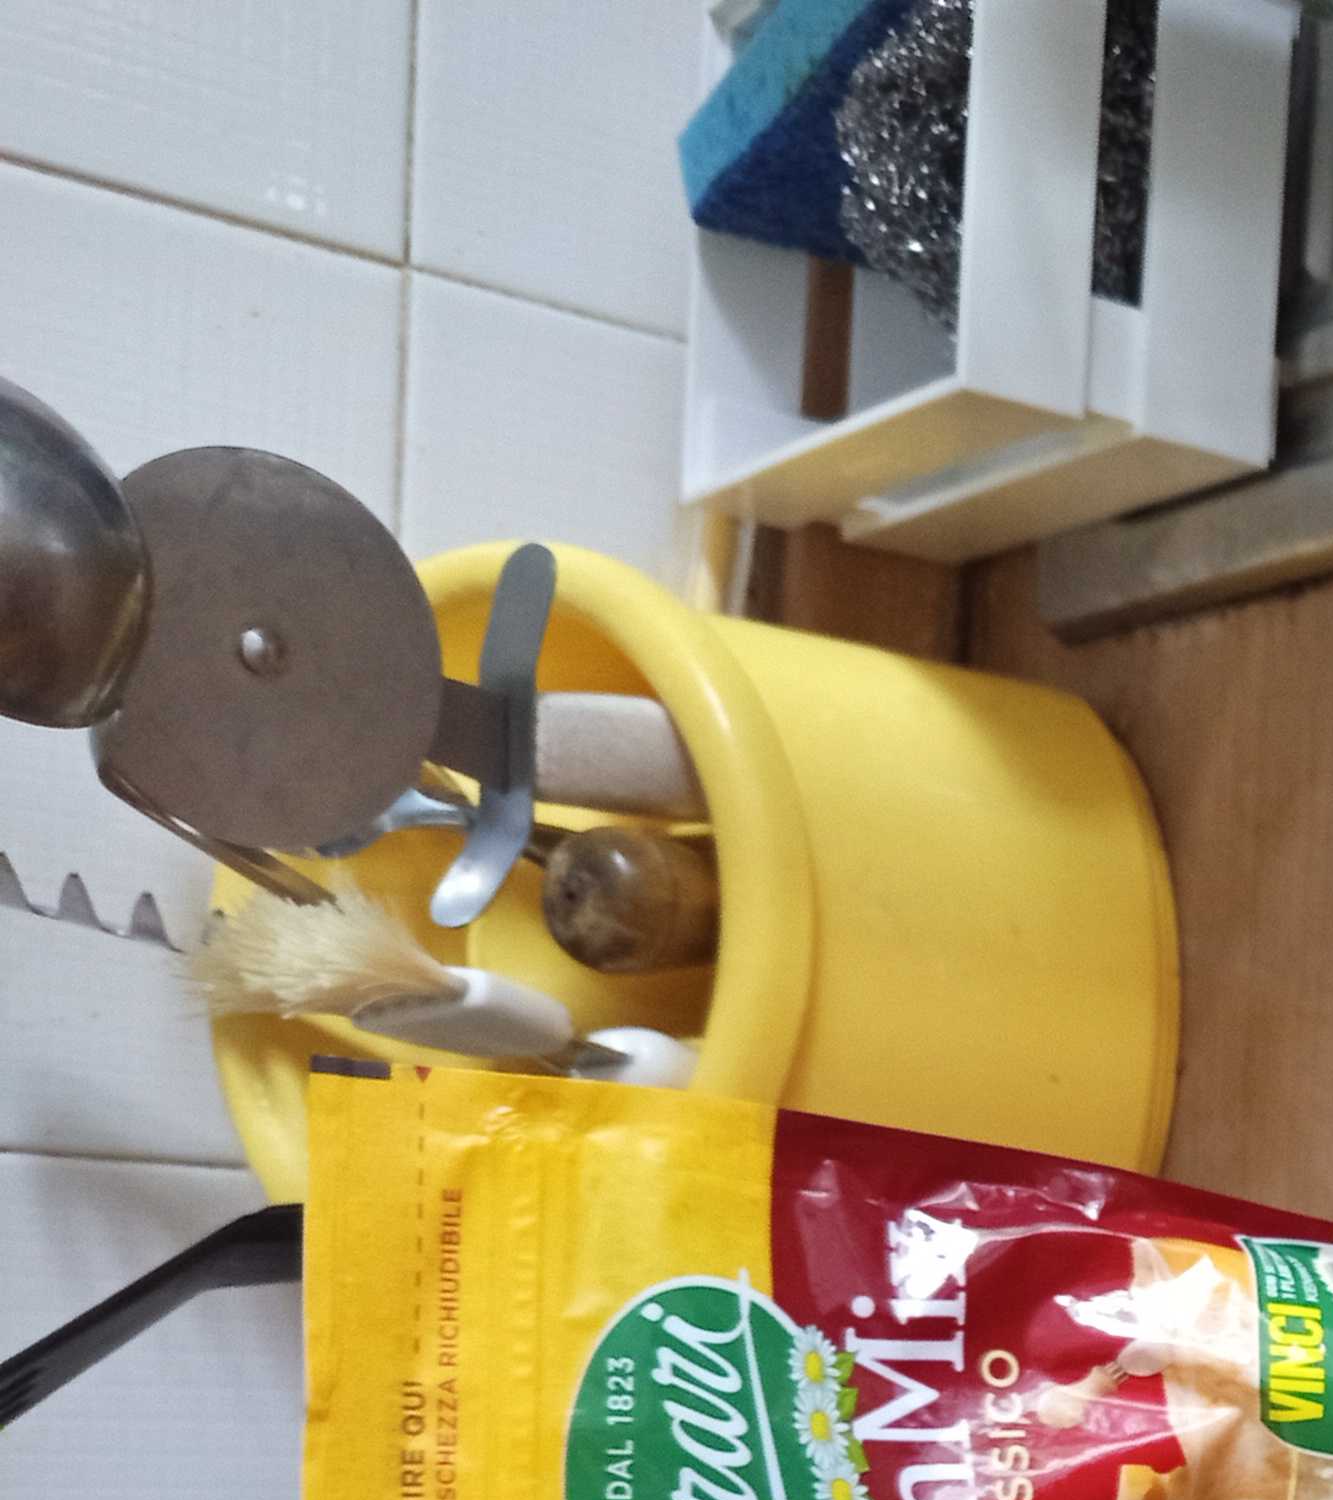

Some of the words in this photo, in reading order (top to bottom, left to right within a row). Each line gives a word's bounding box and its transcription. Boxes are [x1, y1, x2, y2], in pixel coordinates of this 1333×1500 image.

[438, 1188, 462, 1367] RICHIUDIBILE
[605, 1356, 635, 1427] 1823
[1267, 1301, 1326, 1423] VINCI
[401, 1380, 426, 1437] QUI
[605, 1439, 634, 1500] DAL
